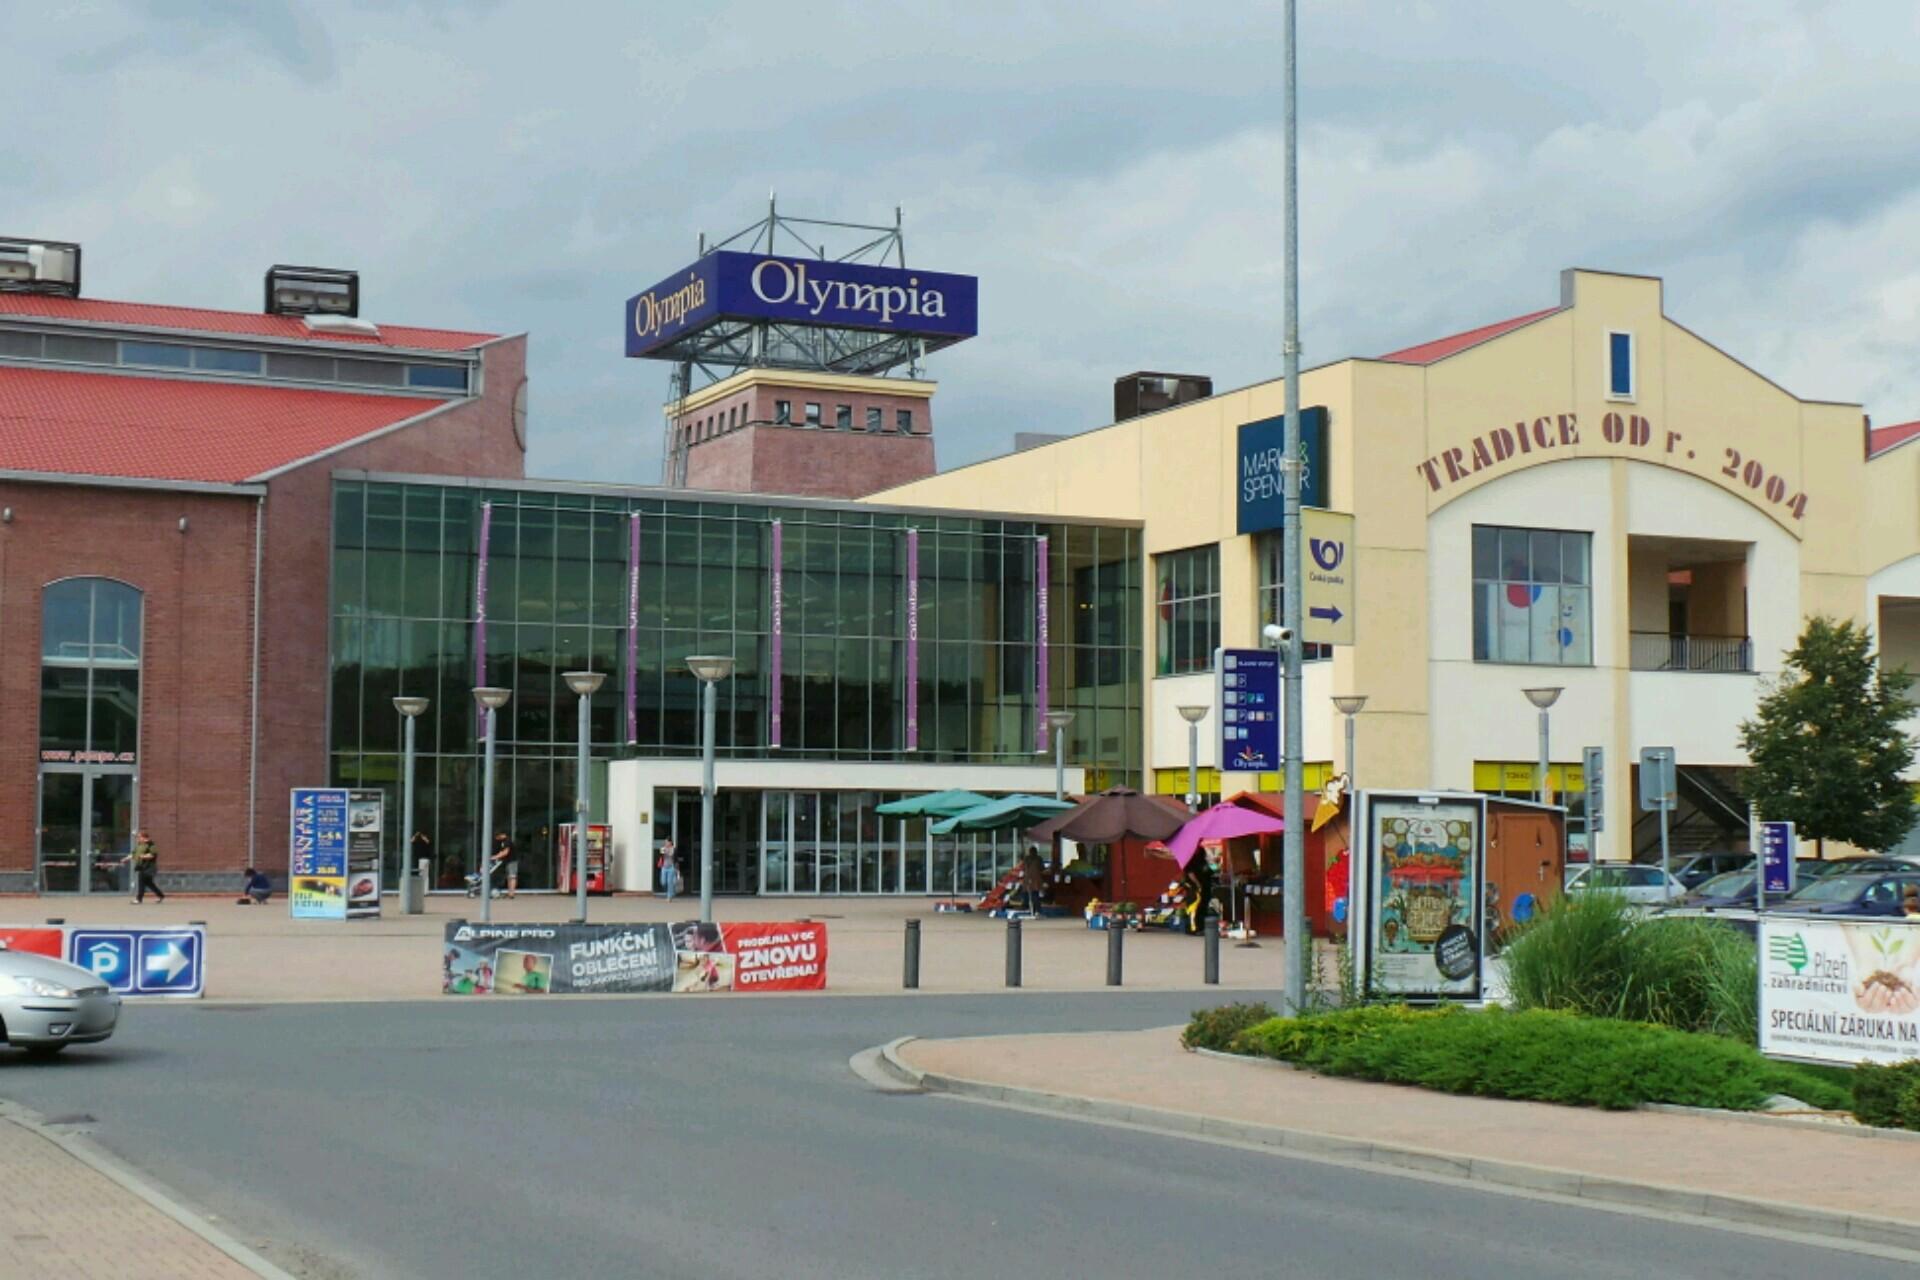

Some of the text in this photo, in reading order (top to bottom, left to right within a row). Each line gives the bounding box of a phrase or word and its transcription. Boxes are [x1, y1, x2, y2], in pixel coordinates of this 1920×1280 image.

[635, 272, 705, 336] Olympia
[751, 260, 946, 322] Olympia
[1416, 412, 1808, 520] TRADICE OD r. 2004
[1244, 466, 1310, 503] SPENR
[570, 928, 655, 961] FUNKČNÍ
[739, 943, 817, 969] ZNOVU
[572, 951, 657, 977] OBLEČENÍ
[740, 963, 818, 984] OTEVŘENA!
[1814, 951, 1848, 978] Plzeň
[1770, 1008, 1918, 1042] SPECIÁLNÍ ZÁRUKA NA
